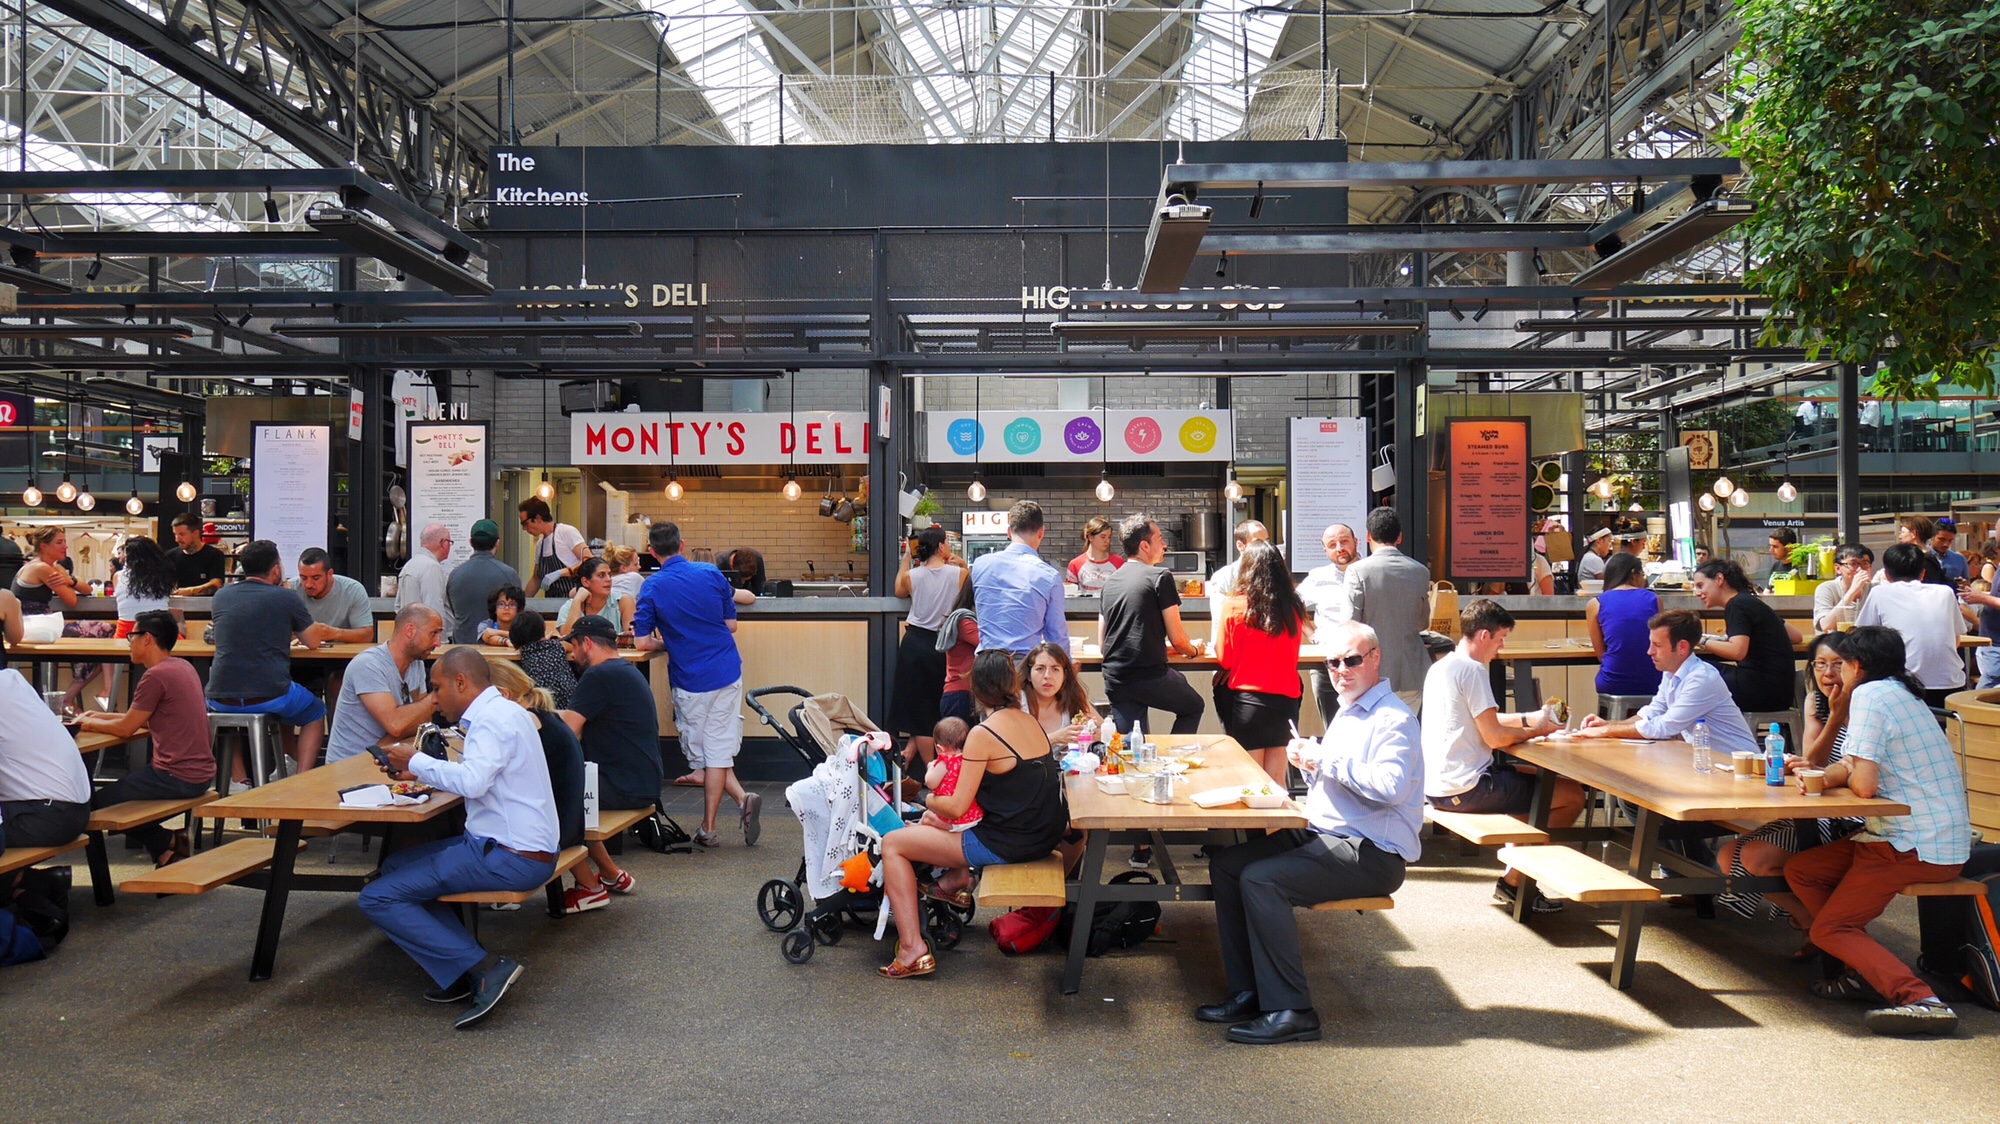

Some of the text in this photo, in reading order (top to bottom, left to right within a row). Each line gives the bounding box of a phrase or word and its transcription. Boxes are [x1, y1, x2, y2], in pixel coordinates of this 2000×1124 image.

[498, 152, 535, 172] The
[496, 187, 589, 206] Kitchens
[652, 283, 707, 307] DELI
[429, 402, 468, 421] MENU
[264, 429, 317, 439] FLANK
[586, 421, 746, 456] MONTY'S
[780, 422, 870, 455] DELI
